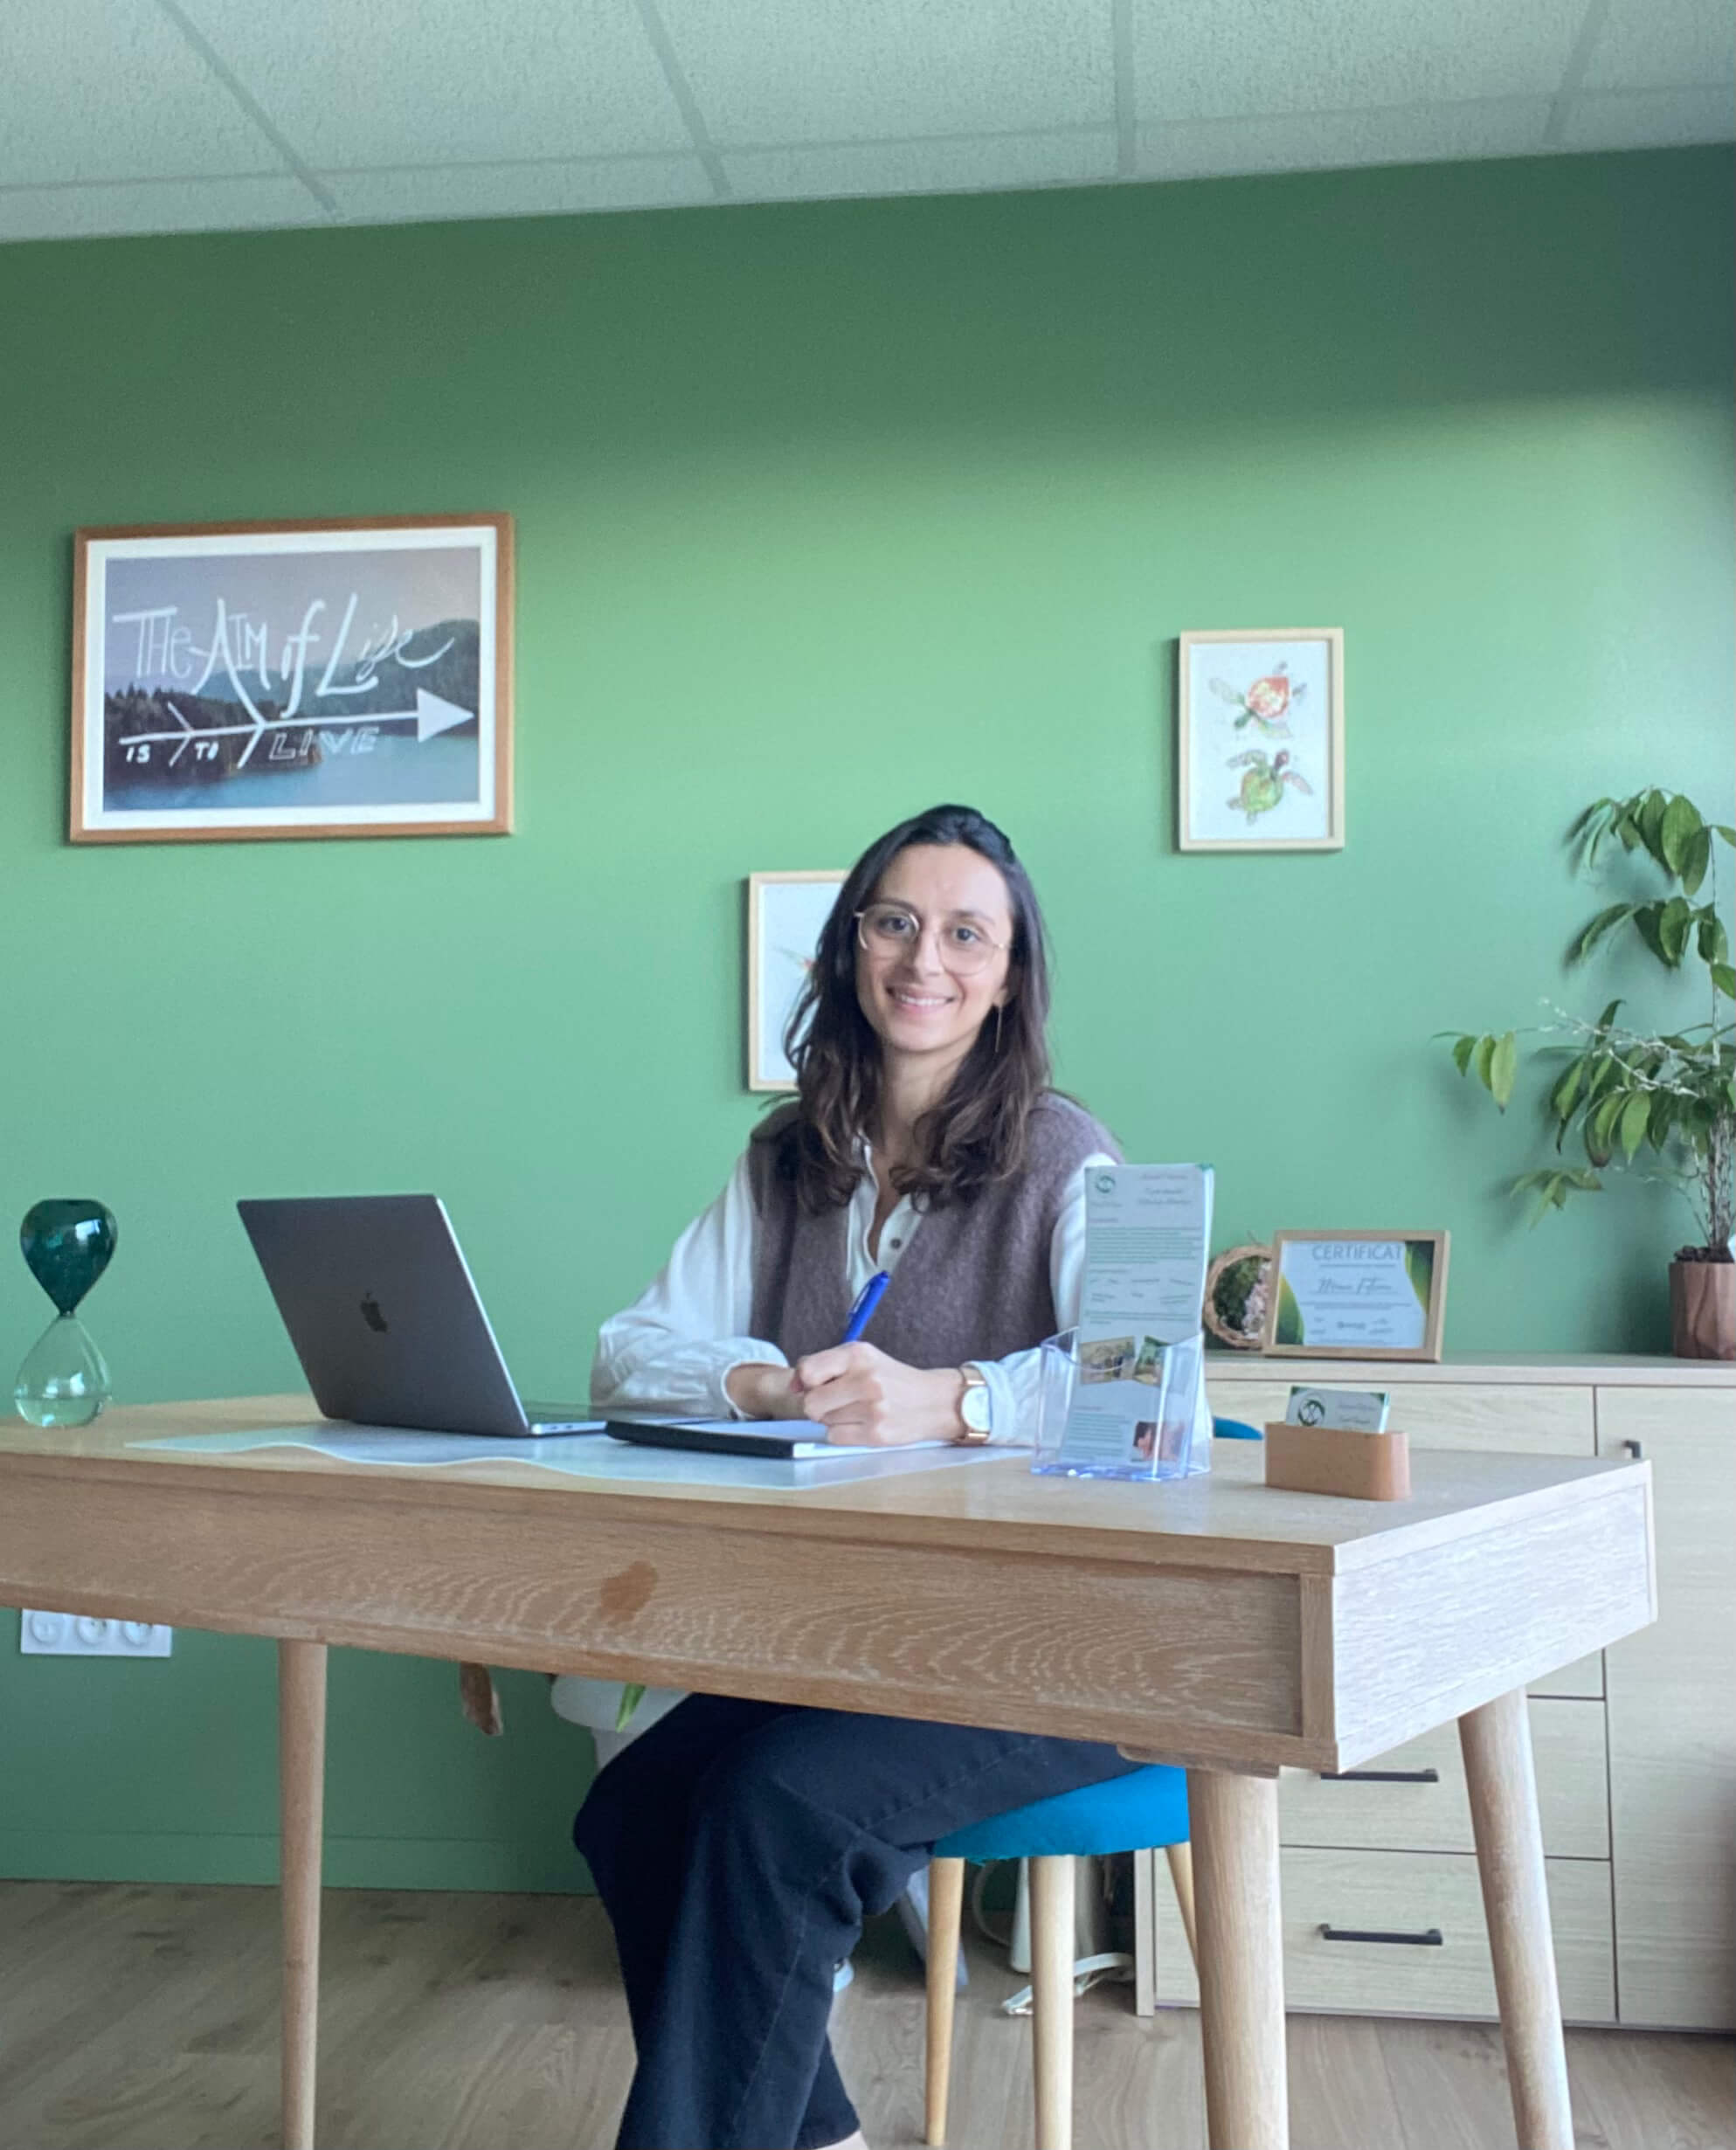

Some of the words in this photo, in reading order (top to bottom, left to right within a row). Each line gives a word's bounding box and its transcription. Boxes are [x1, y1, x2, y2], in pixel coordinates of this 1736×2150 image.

[187, 597, 271, 722] AIM
[315, 592, 454, 697] Life
[126, 744, 151, 763] IS
[194, 742, 219, 760] TO
[268, 726, 380, 761] LIVE
[1311, 1244, 1402, 1260] CERTIFICAT
